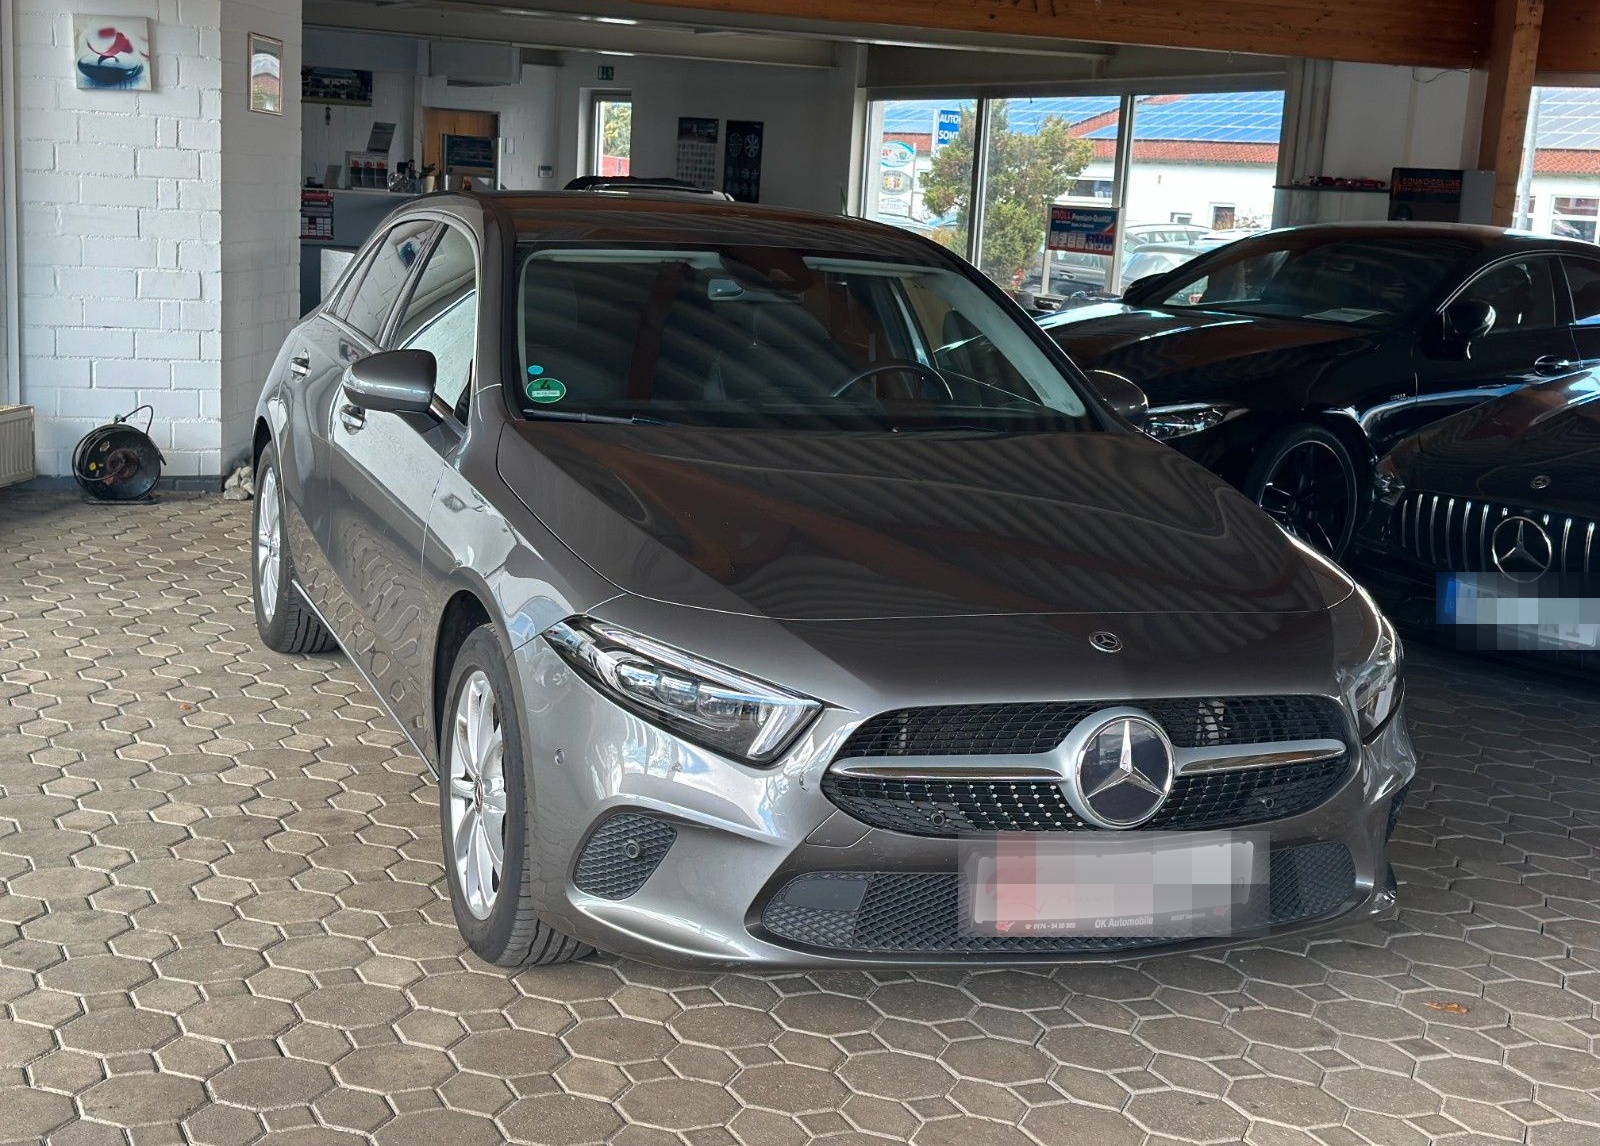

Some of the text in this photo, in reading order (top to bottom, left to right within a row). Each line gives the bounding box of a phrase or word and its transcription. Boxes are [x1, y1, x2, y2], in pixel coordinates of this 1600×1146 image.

[540, 379, 551, 390] 4
[1095, 916, 1153, 929] OK Automobile
